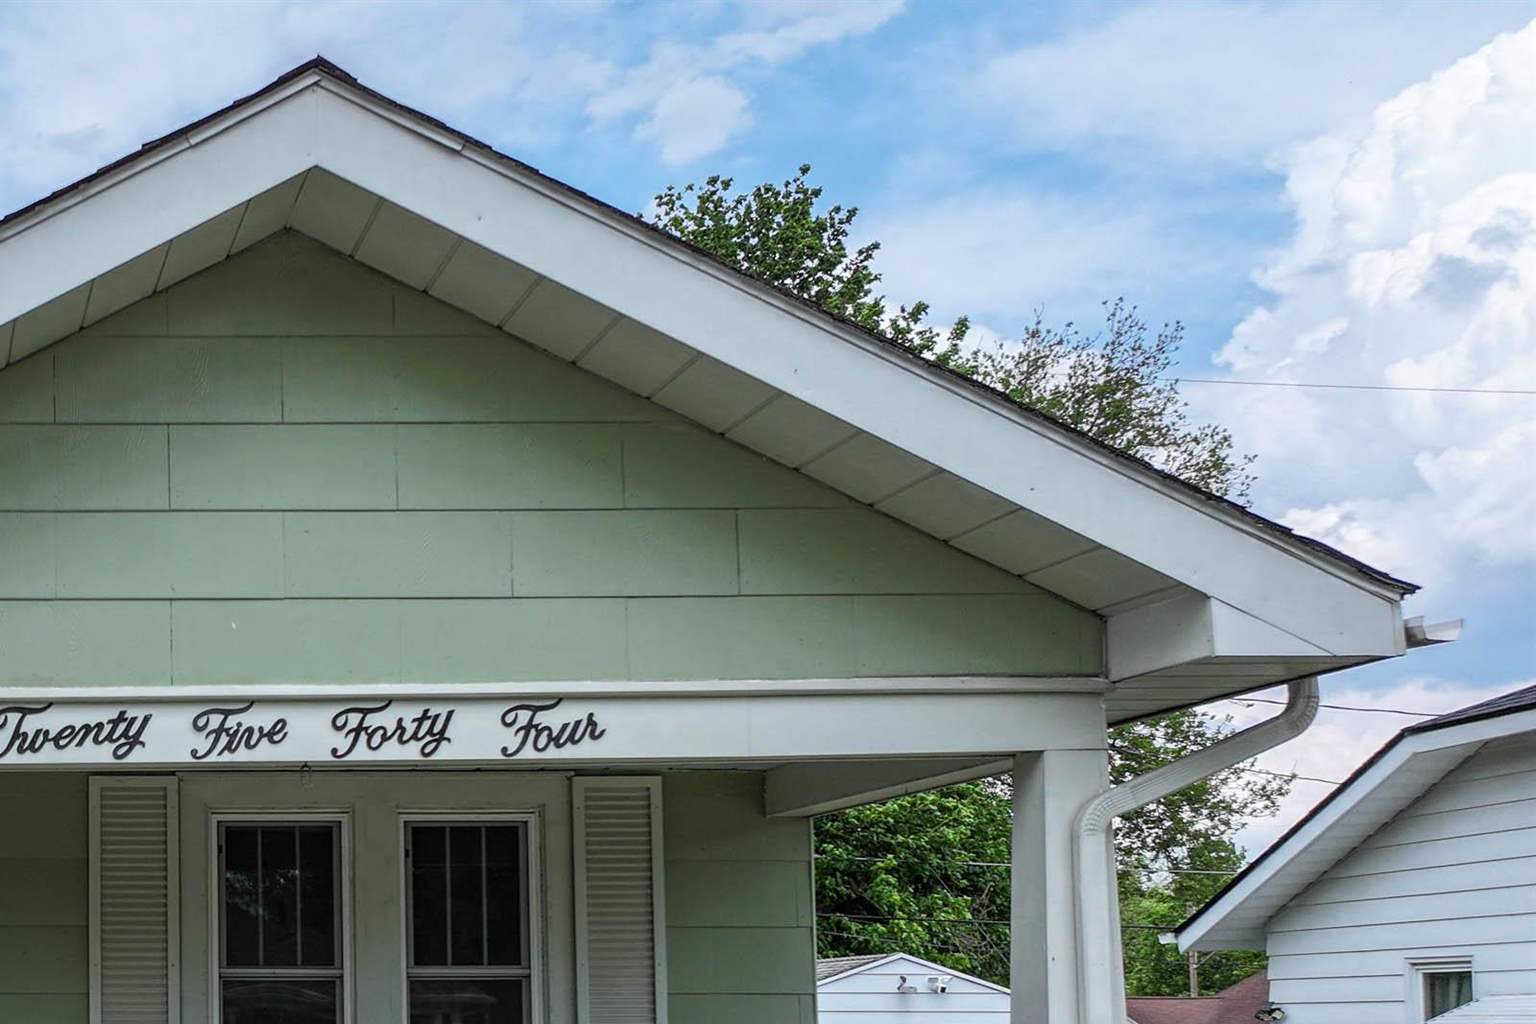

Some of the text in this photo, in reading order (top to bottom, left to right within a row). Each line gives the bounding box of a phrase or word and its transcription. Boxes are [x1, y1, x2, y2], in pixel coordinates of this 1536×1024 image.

[190, 700, 288, 760] Five
[330, 700, 456, 759] Forty
[500, 697, 607, 758] Four
